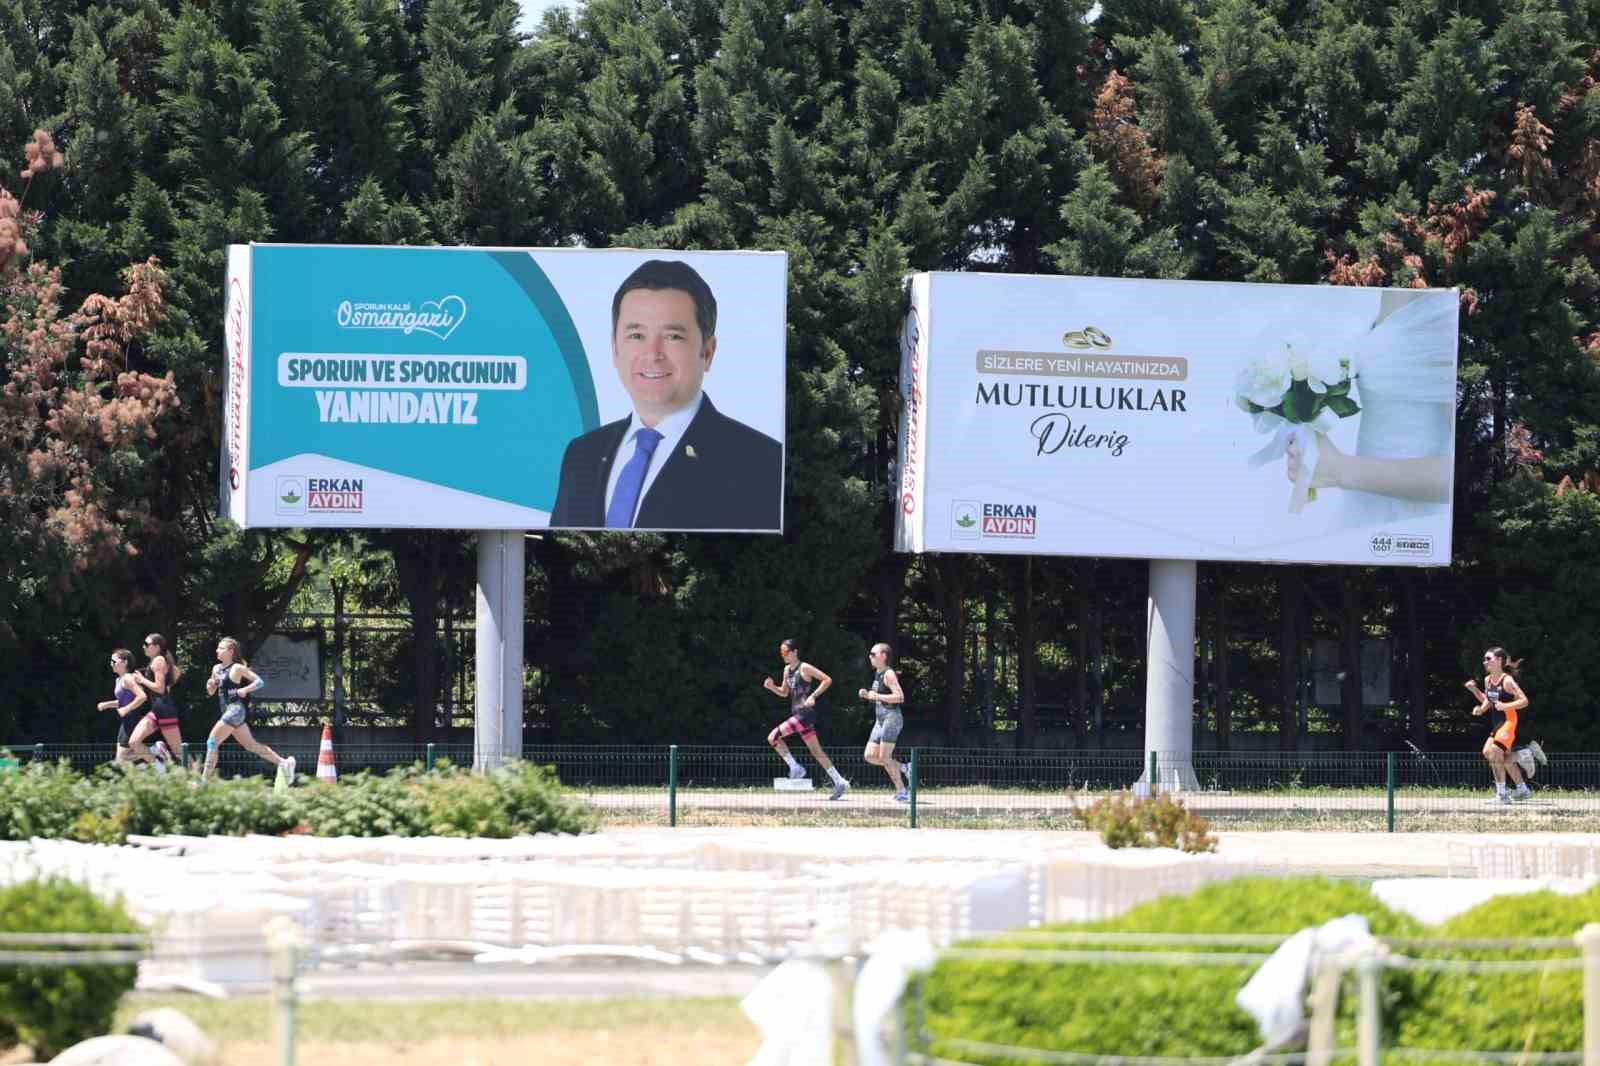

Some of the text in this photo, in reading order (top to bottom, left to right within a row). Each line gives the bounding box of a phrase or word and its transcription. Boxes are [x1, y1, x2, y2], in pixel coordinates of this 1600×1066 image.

[337, 300, 453, 335] Osmangazi
[287, 359, 517, 384] SPORUN VE SPORCUNUN
[983, 355, 1180, 376] SİZLERE YENİ HAYATINIZDA
[314, 391, 478, 425] YANINDAYIZ
[975, 382, 1187, 413] MUTLULUKLAR
[1030, 412, 1131, 457] Dileriz
[308, 479, 363, 491] ERKAN
[310, 493, 361, 507] AYDIN
[983, 503, 1037, 518] ERKAN
[984, 518, 1035, 533] AYDIN
